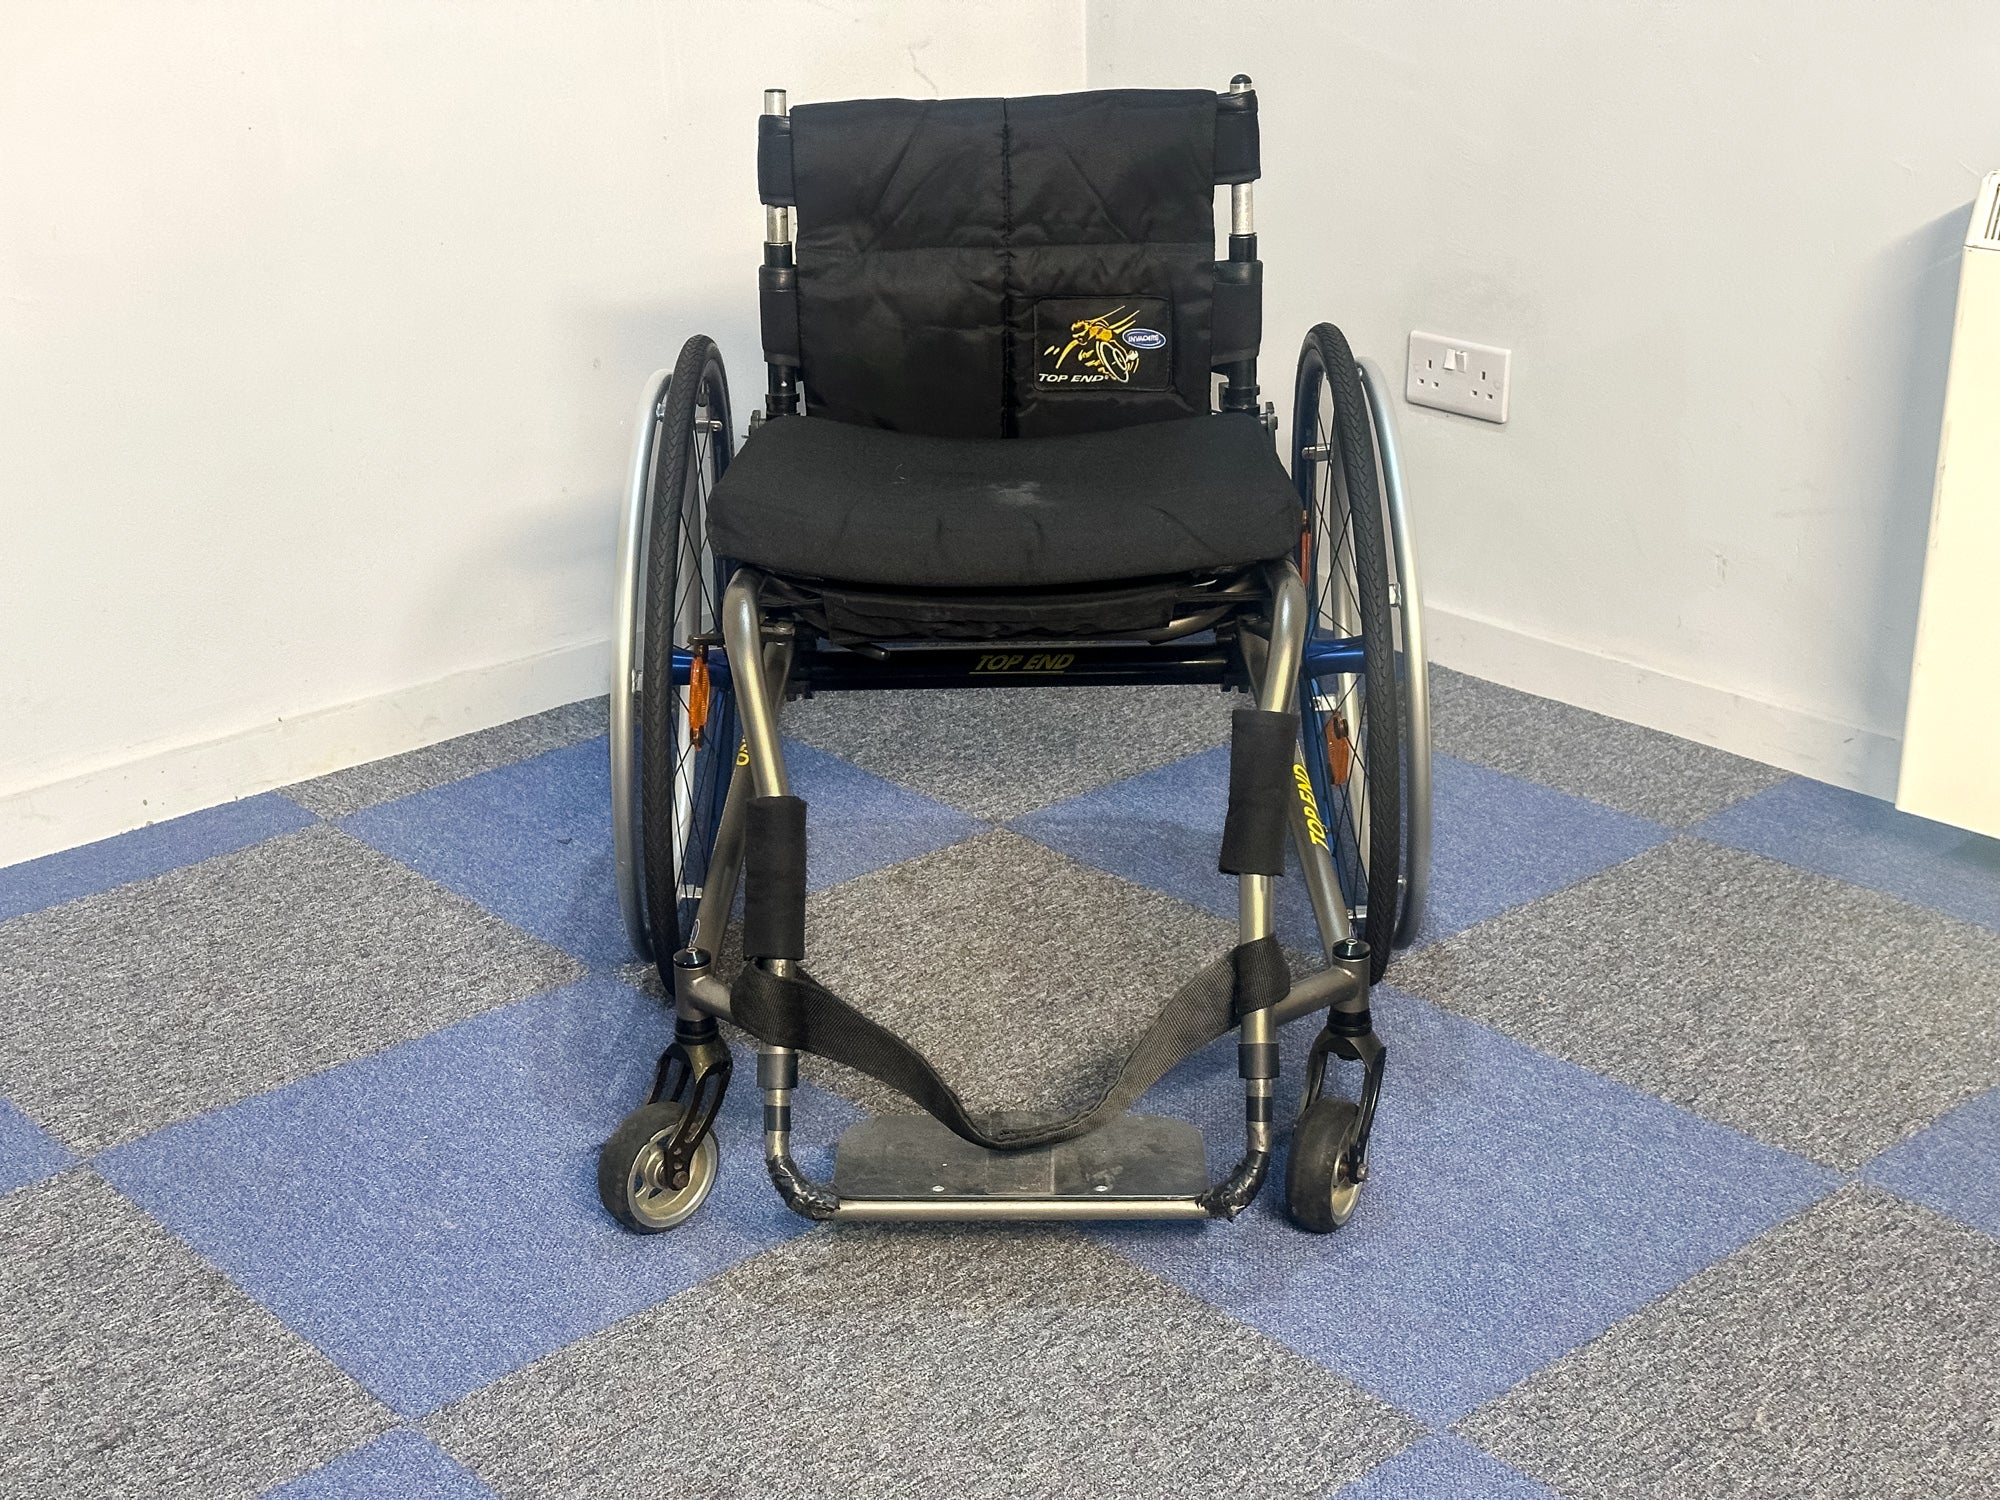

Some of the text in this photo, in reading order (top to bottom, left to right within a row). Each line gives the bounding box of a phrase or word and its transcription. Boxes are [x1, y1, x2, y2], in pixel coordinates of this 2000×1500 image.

[1038, 373, 1068, 383] TOP
[975, 654, 1075, 670] TOP END
[1293, 763, 1330, 852] TOP END
